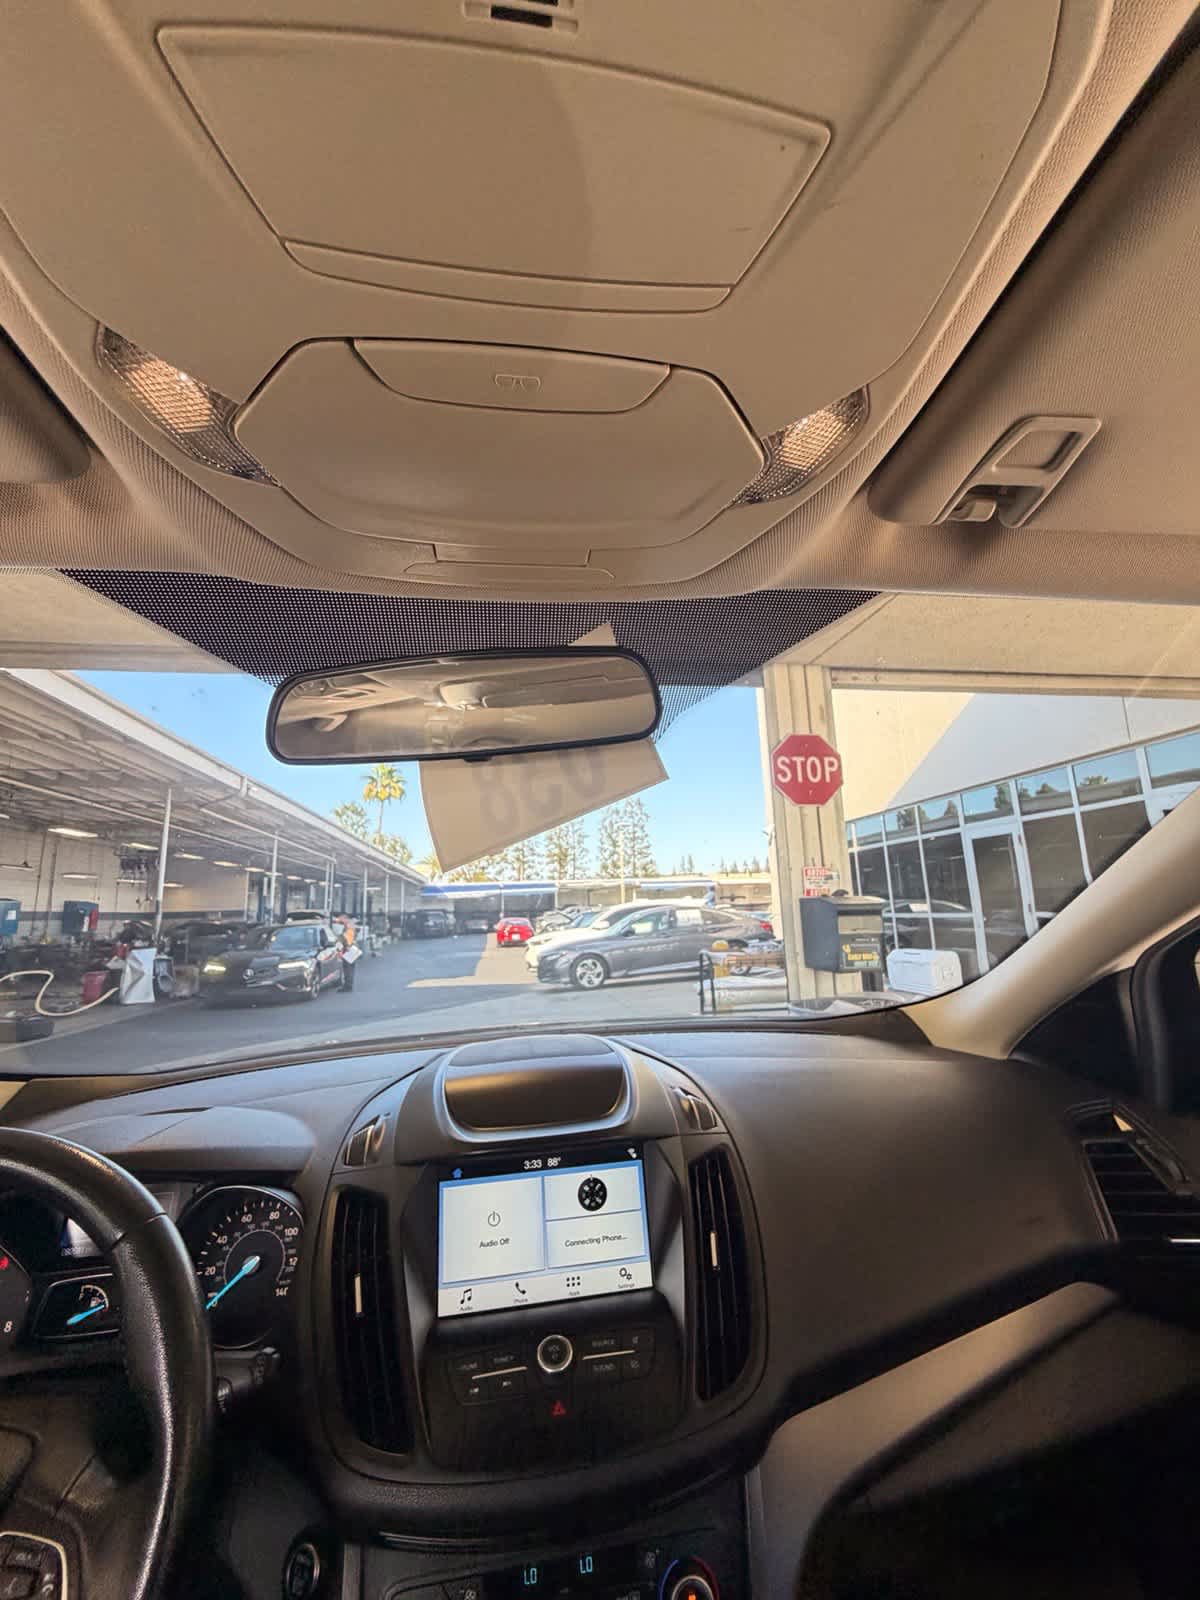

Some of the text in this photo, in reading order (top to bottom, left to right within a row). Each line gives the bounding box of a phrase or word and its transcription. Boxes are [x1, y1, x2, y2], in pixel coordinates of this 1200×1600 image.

[776, 756, 838, 783] STOP
[523, 1158, 543, 1170] 3:33
[241, 1214, 253, 1223] 60
[269, 1211, 280, 1220] 80
[284, 1227, 299, 1236] 100
[216, 1235, 228, 1244] 40
[479, 1237, 510, 1248] Audio Off
[564, 1237, 601, 1248] Connecting
[204, 1267, 216, 1275] 20
[5, 1321, 12, 1332] 8
[579, 1555, 593, 1575] LO
[524, 1567, 537, 1585] LO
